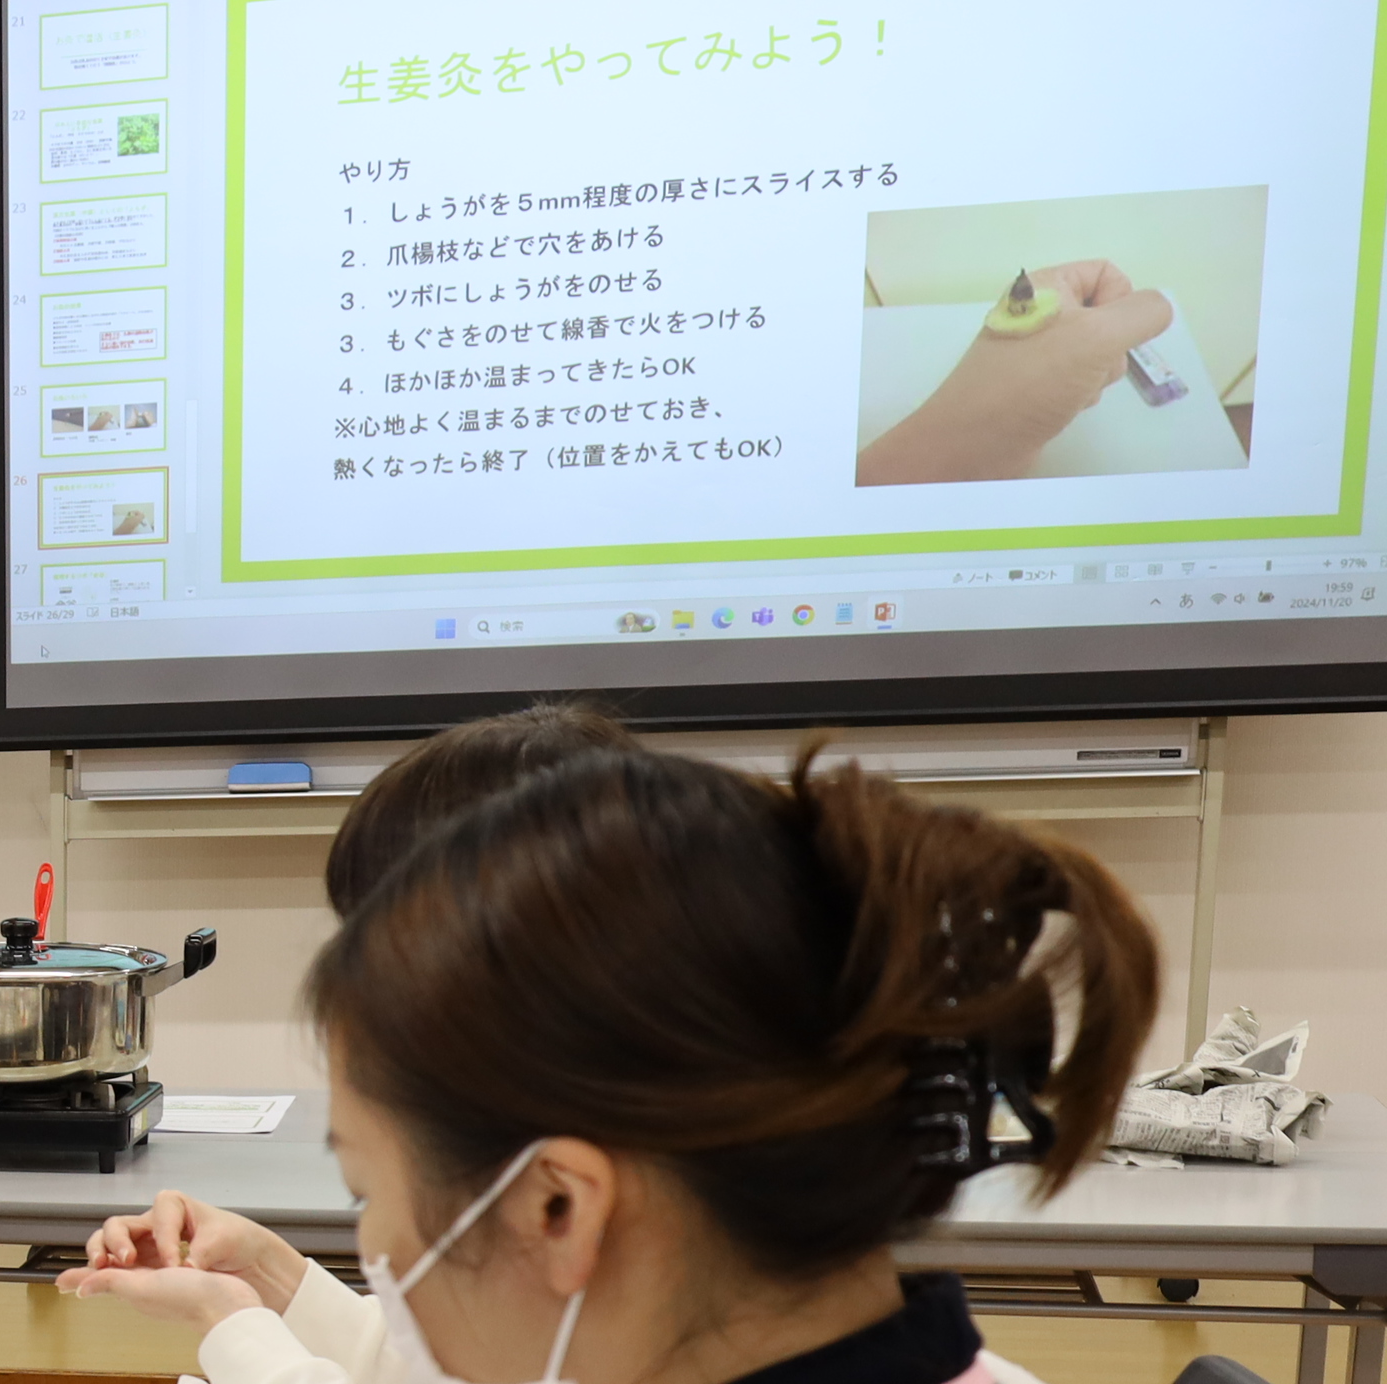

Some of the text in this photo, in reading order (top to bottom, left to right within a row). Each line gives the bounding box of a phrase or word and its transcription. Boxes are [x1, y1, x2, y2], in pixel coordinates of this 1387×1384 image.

[12, 17, 25, 27] 21
[338, 19, 887, 104] 生姜灸をやってみよう！
[12, 110, 25, 121] 22
[340, 158, 411, 183] やり方
[13, 203, 26, 213] 23
[387, 224, 664, 267] 爪楊枝などで穴をあける
[387, 269, 663, 309] ツボにしょうがをのせる
[13, 295, 26, 305] 24
[387, 306, 766, 352] もぐさをのせて線香で火をつける
[385, 357, 696, 393] ほかほか温まってきたらOK
[13, 386, 26, 395] 25
[335, 396, 723, 438] ※心地よく温まるまでのせておき、
[14, 476, 27, 486] 26
[14, 565, 27, 574] 27
[968, 558, 1367, 582] ノート コメント 97%
[1326, 582, 1354, 593] 19:59
[1180, 593, 1194, 609] あ
[1290, 597, 1352, 610] 2024/11/20
[16, 607, 139, 620] スライド 26/29 日本語
[500, 621, 523, 632] 検索
